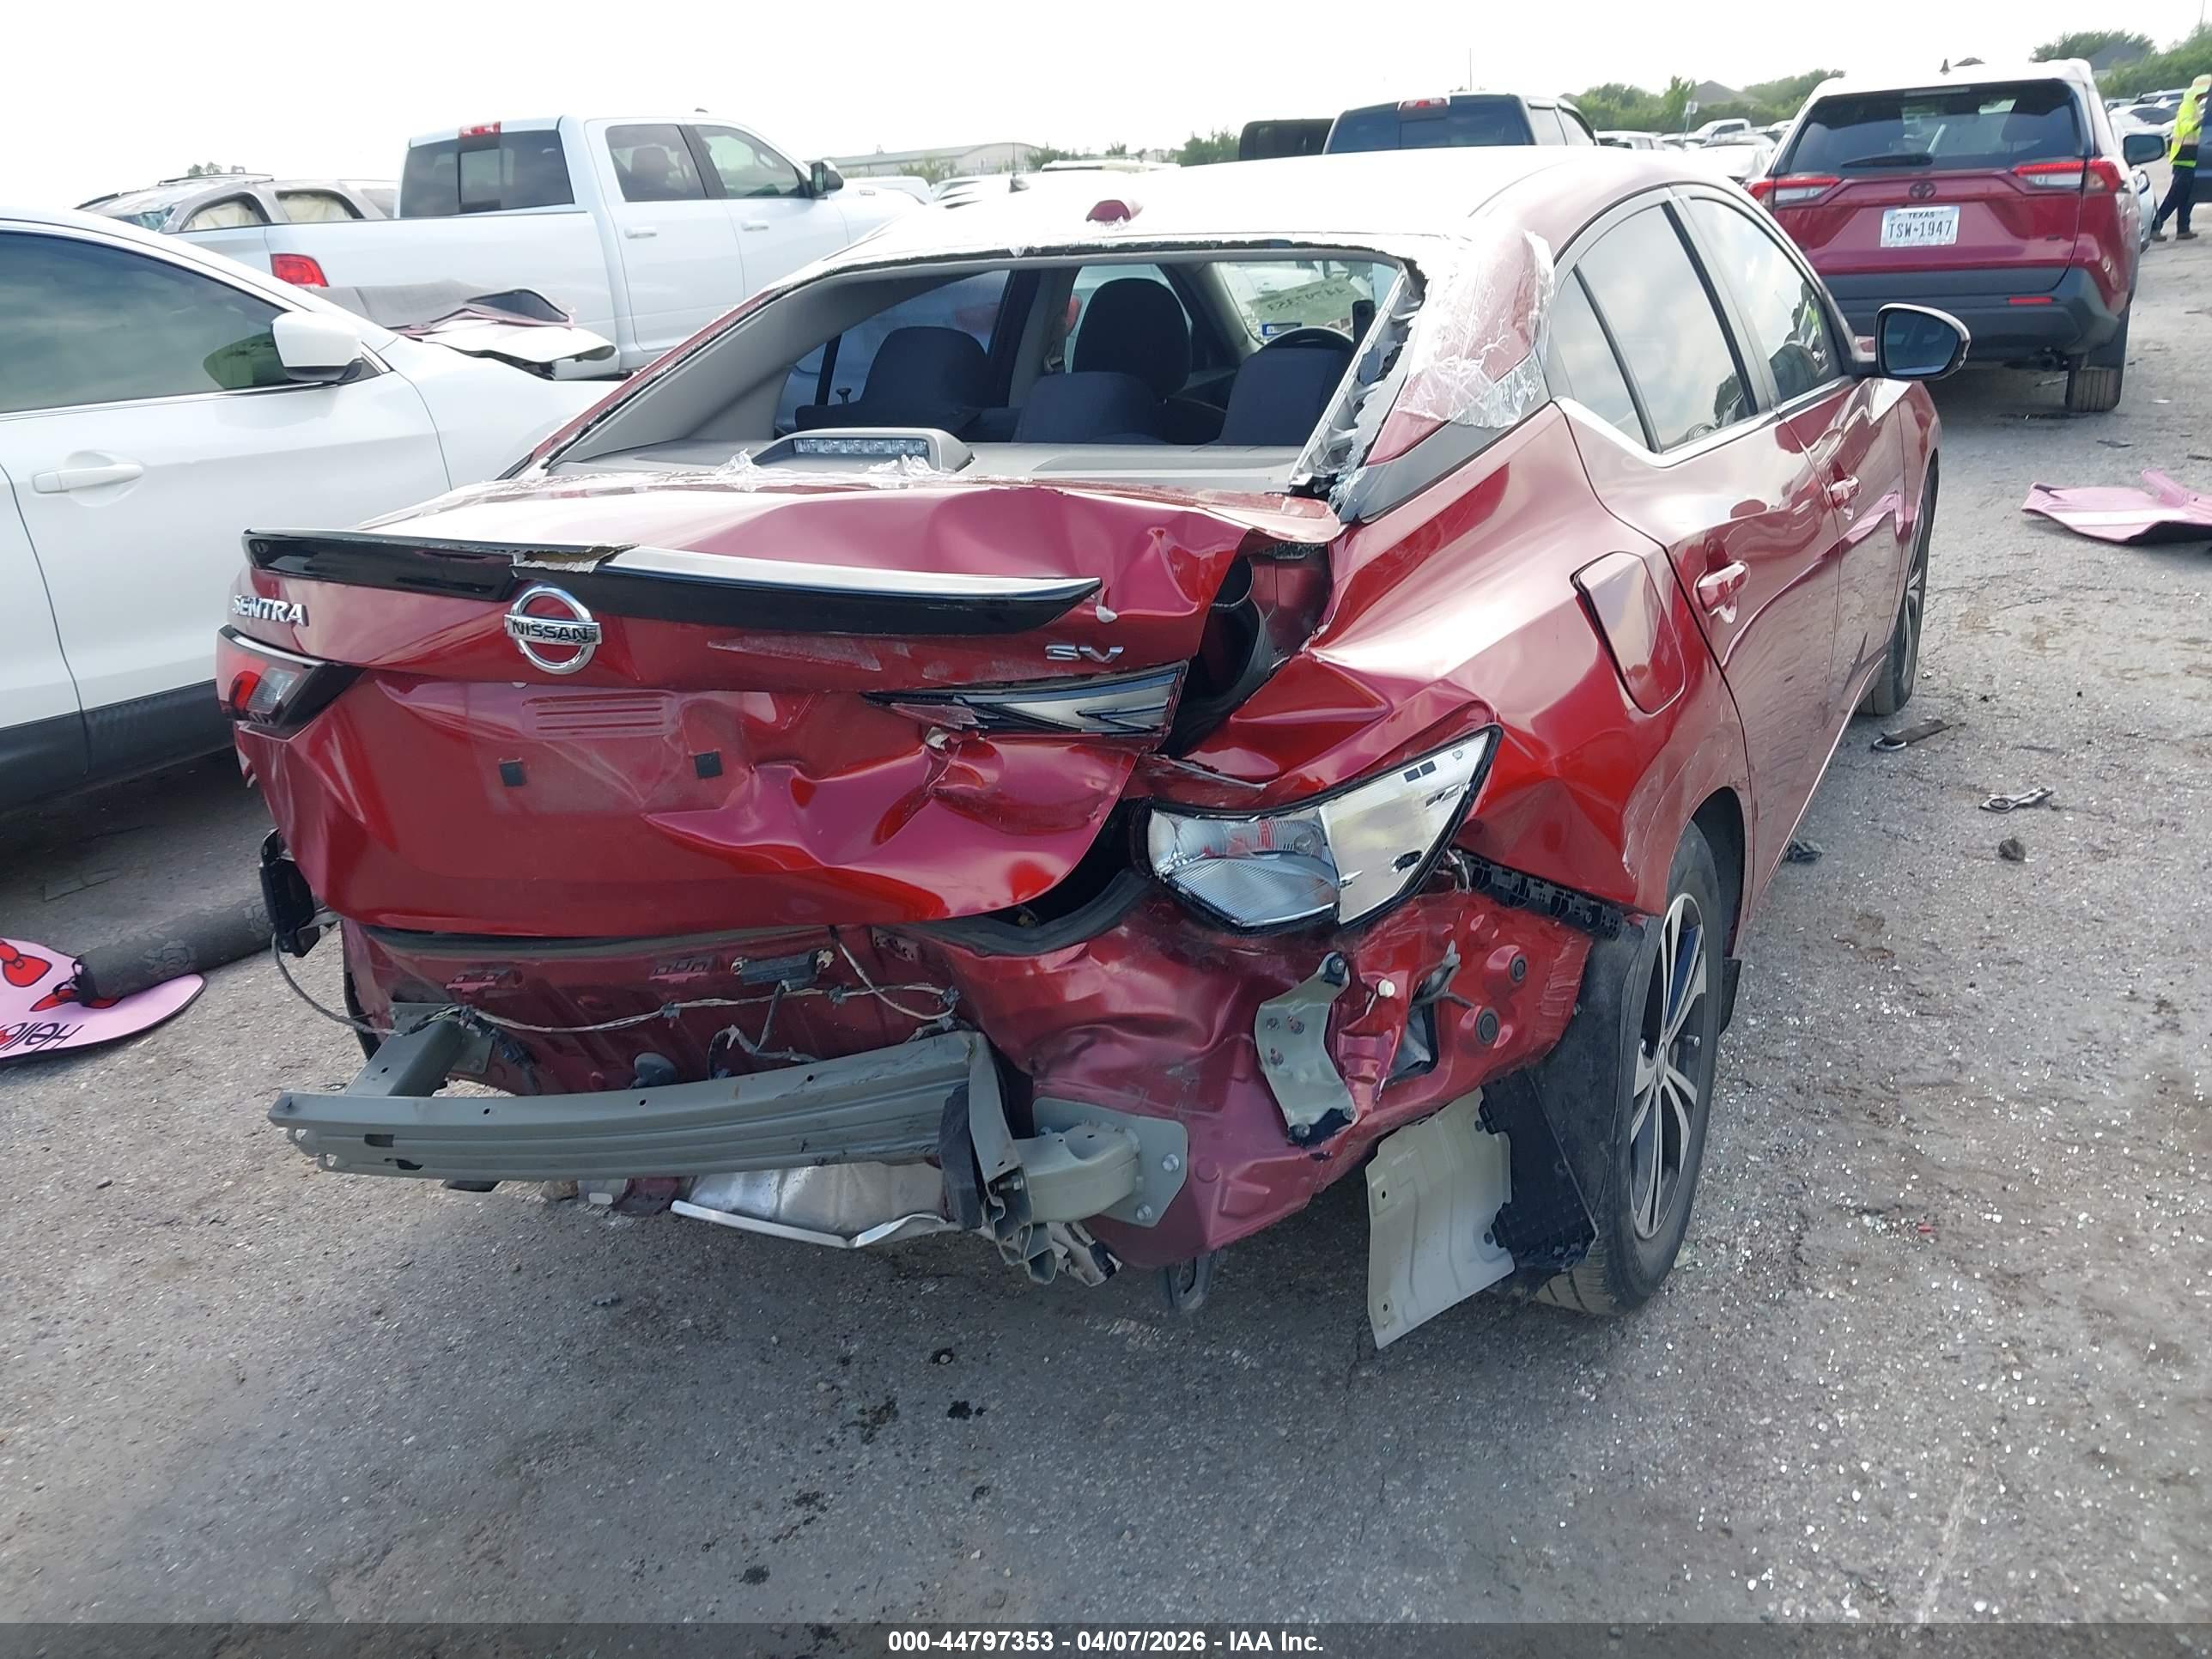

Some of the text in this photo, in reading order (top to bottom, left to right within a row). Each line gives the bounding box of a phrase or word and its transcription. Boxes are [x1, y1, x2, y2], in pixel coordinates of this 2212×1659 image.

[233, 595, 309, 626] SENTRA
[512, 620, 588, 641] NISSAN
[1045, 644, 1123, 663] SV
